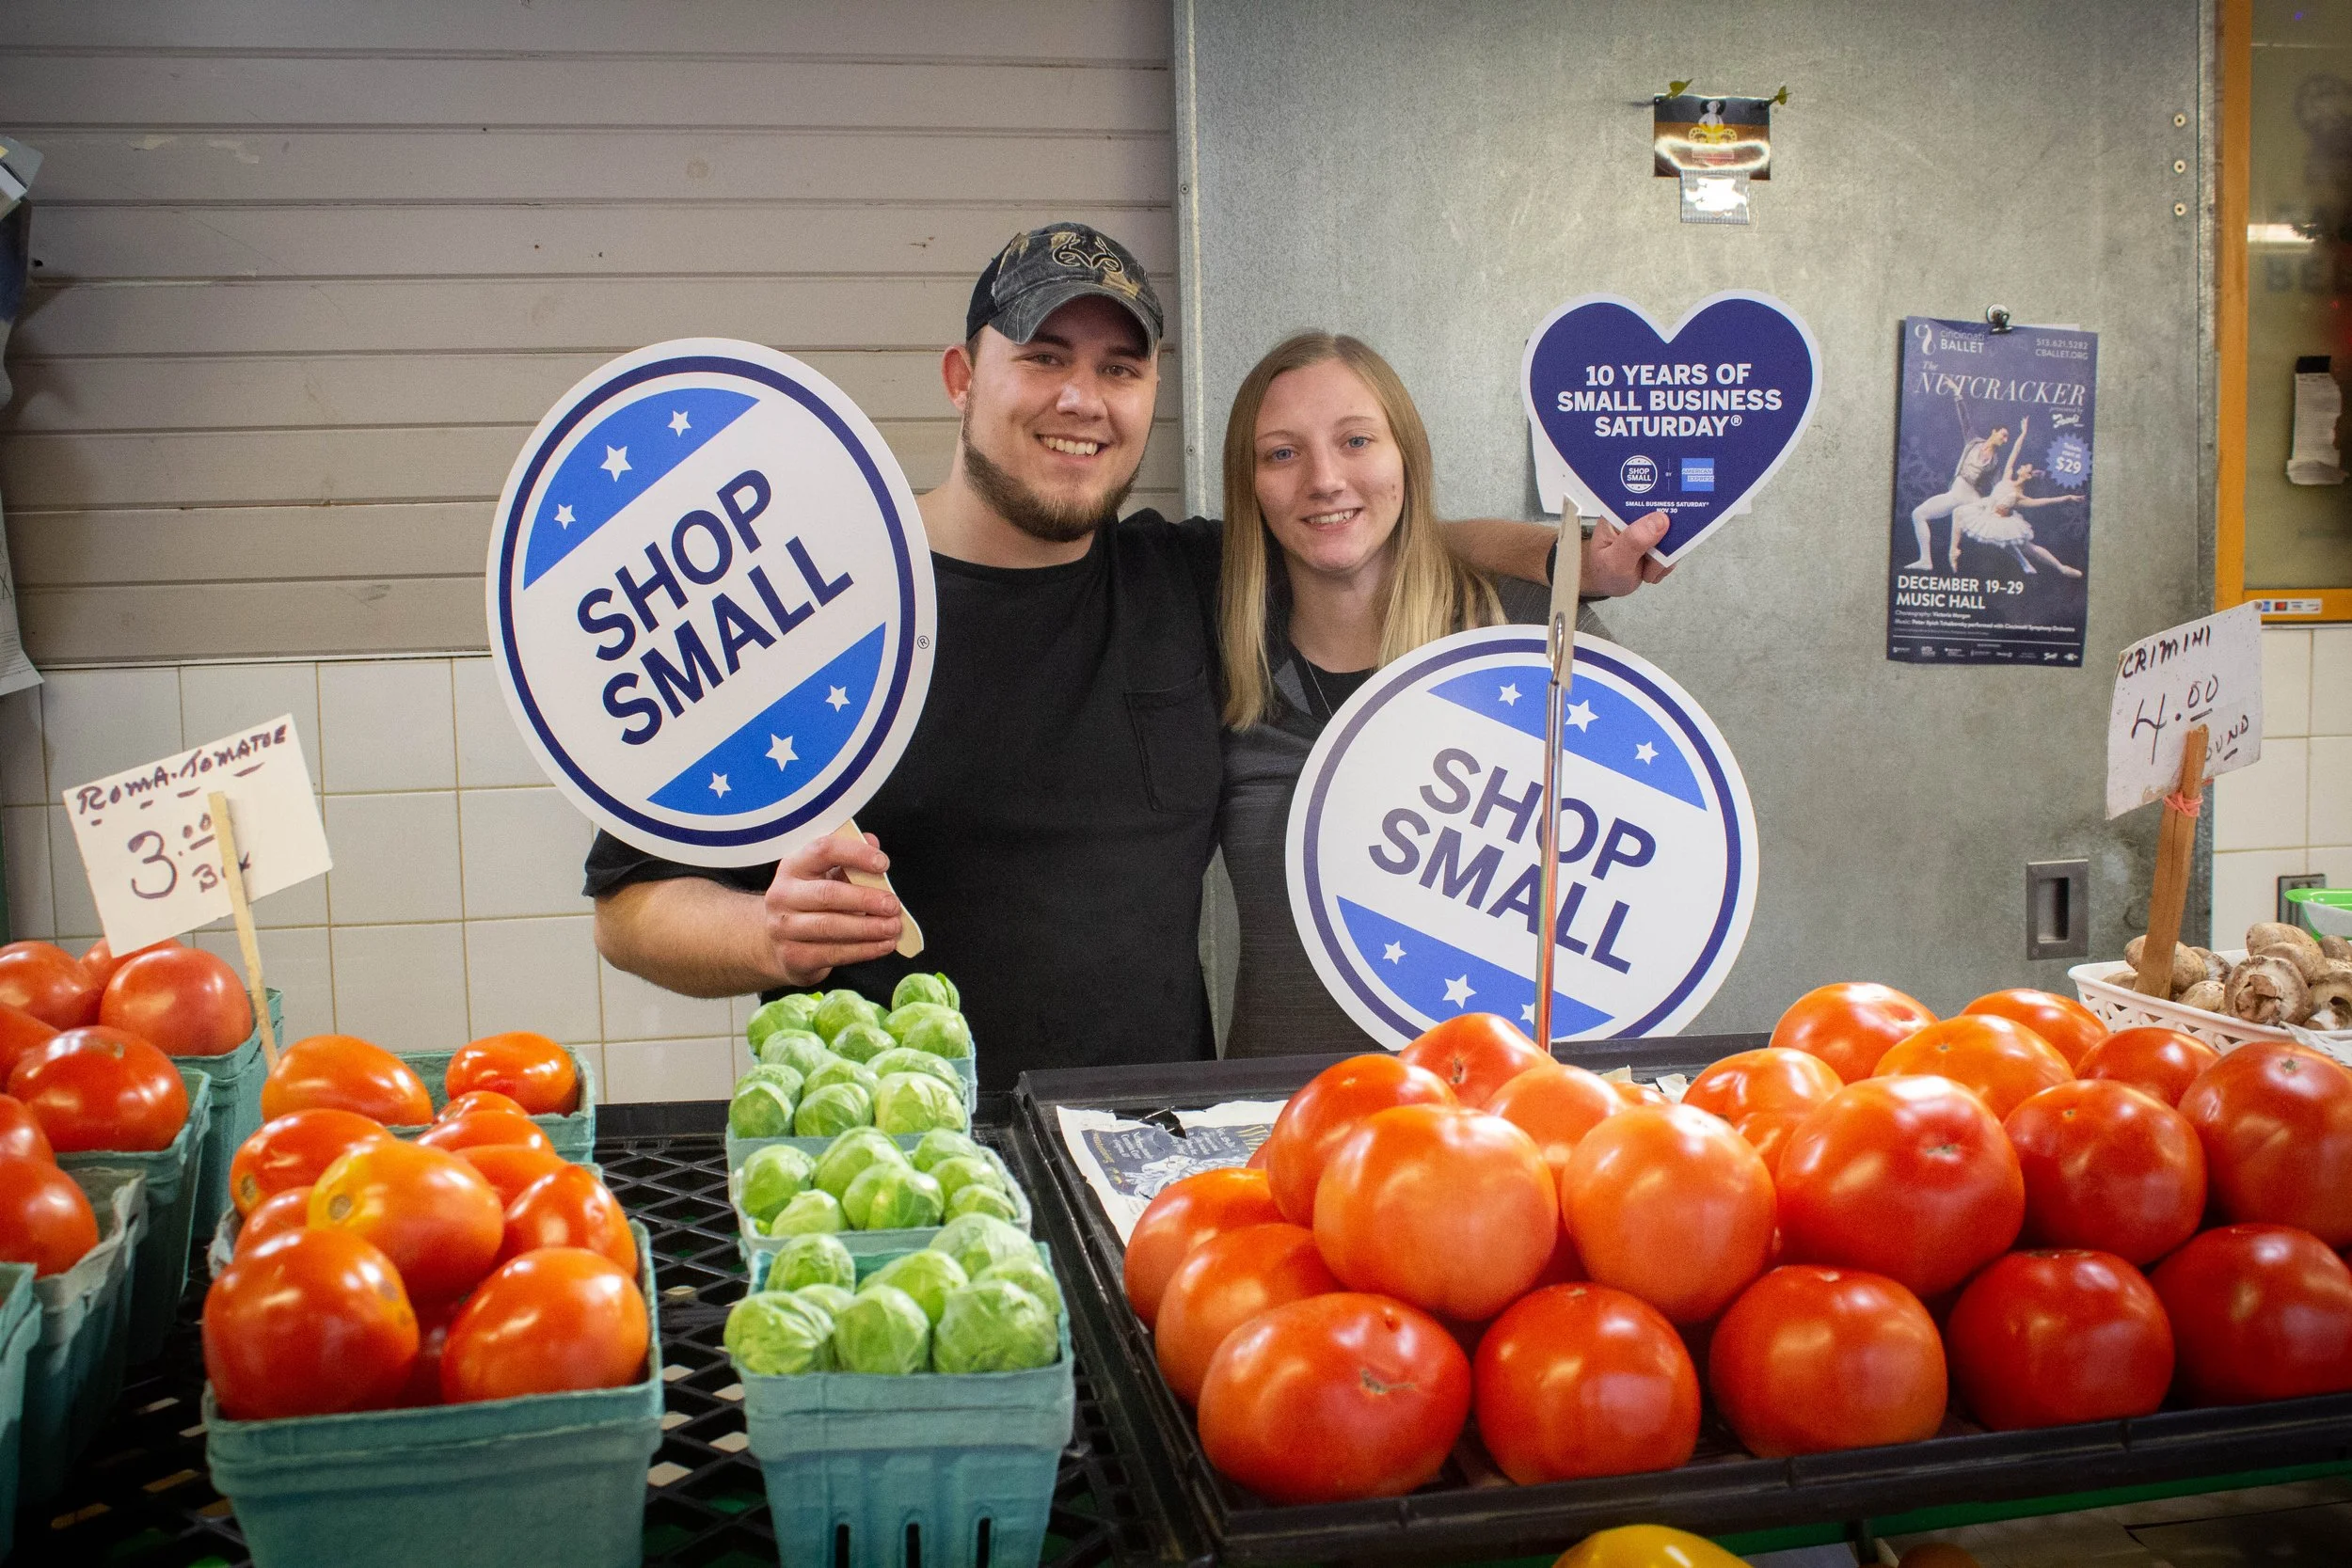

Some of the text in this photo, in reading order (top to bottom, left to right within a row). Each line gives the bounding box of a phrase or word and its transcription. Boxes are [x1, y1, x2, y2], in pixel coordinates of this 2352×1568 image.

[1941, 339, 1985, 354] BALLET
[2035, 348, 2090, 360] CBALLET.ORG
[1585, 363, 1752, 387] 10 YEARS OF
[1557, 388, 1783, 412] SMALL BUSINESS
[1914, 372, 2086, 406] NUTCRACKER
[2055, 456, 2082, 475] $29
[577, 469, 772, 661] SHOP
[1897, 575, 1980, 593] DECEMBER
[1896, 592, 1986, 610] MUSIC HALL
[602, 535, 854, 746] SMALL
[2122, 625, 2211, 678] CRIMINI
[1419, 747, 1657, 881] SHOP
[1368, 807, 1630, 974] SMALL
